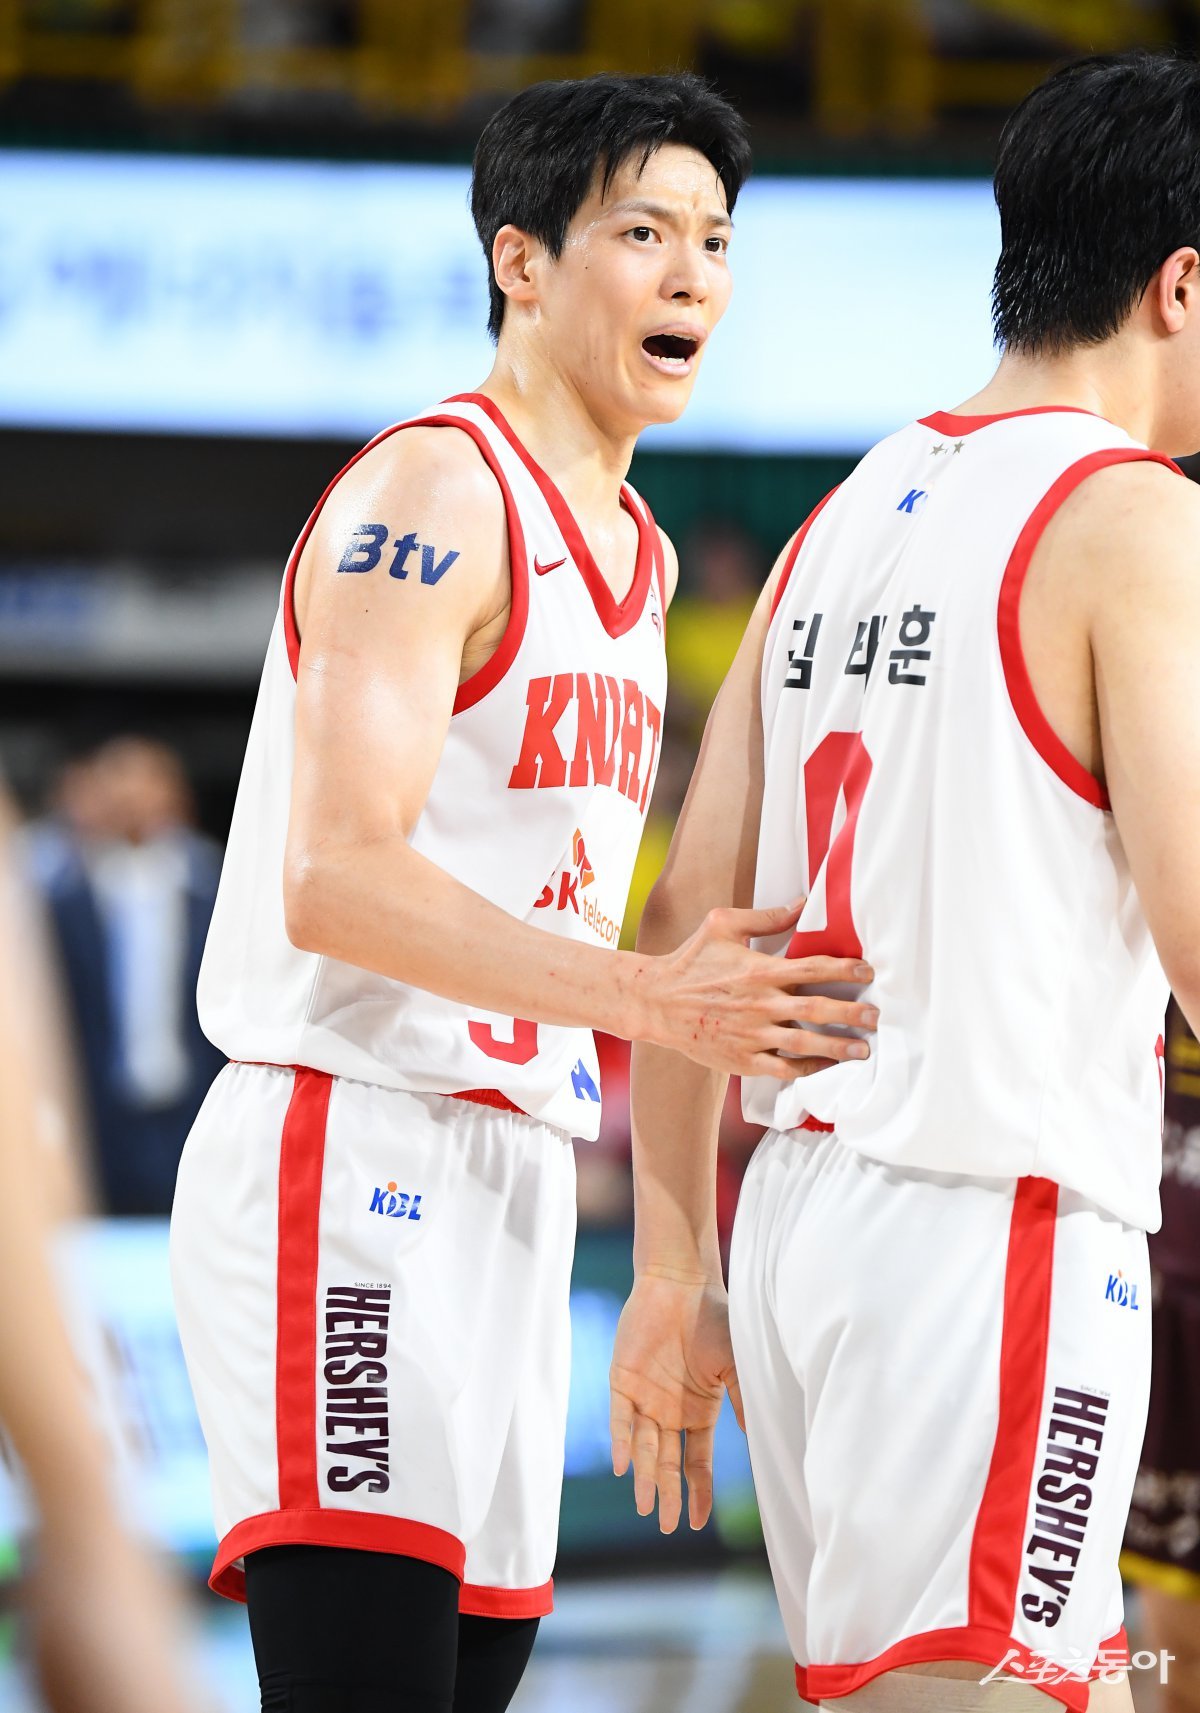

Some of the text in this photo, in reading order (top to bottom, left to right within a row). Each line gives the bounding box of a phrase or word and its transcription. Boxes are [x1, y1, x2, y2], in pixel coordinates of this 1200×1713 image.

[369, 1185, 422, 1221] KBL
[354, 1281, 375, 1289] SINCE
[1105, 1273, 1139, 1311] KBL
[323, 1286, 392, 1494] HERSHEY'S
[1021, 1386, 1110, 1628] HERSHEY'S
